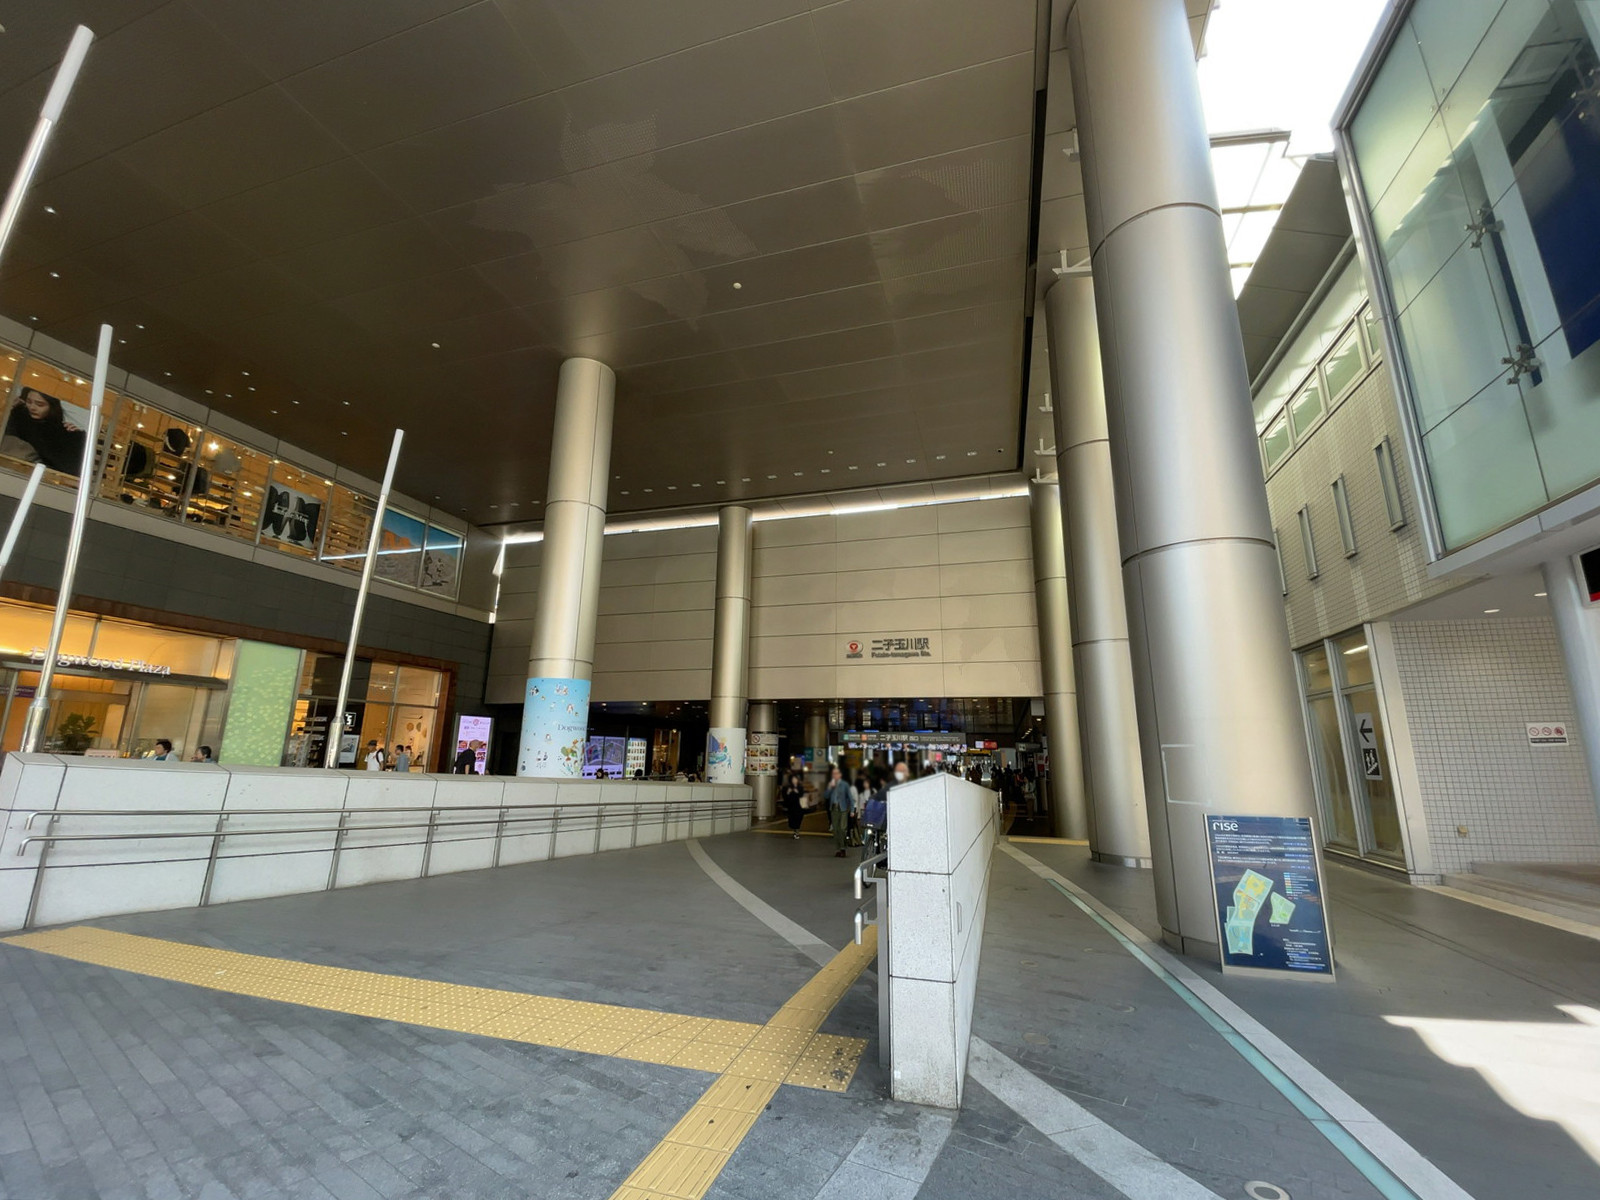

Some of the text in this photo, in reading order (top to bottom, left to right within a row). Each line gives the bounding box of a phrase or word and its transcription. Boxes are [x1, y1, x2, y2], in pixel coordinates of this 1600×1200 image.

[871, 638, 930, 651] 二子玉川駅
[28, 646, 171, 676] Dgwood Plaza
[1212, 821, 1239, 831] rise
